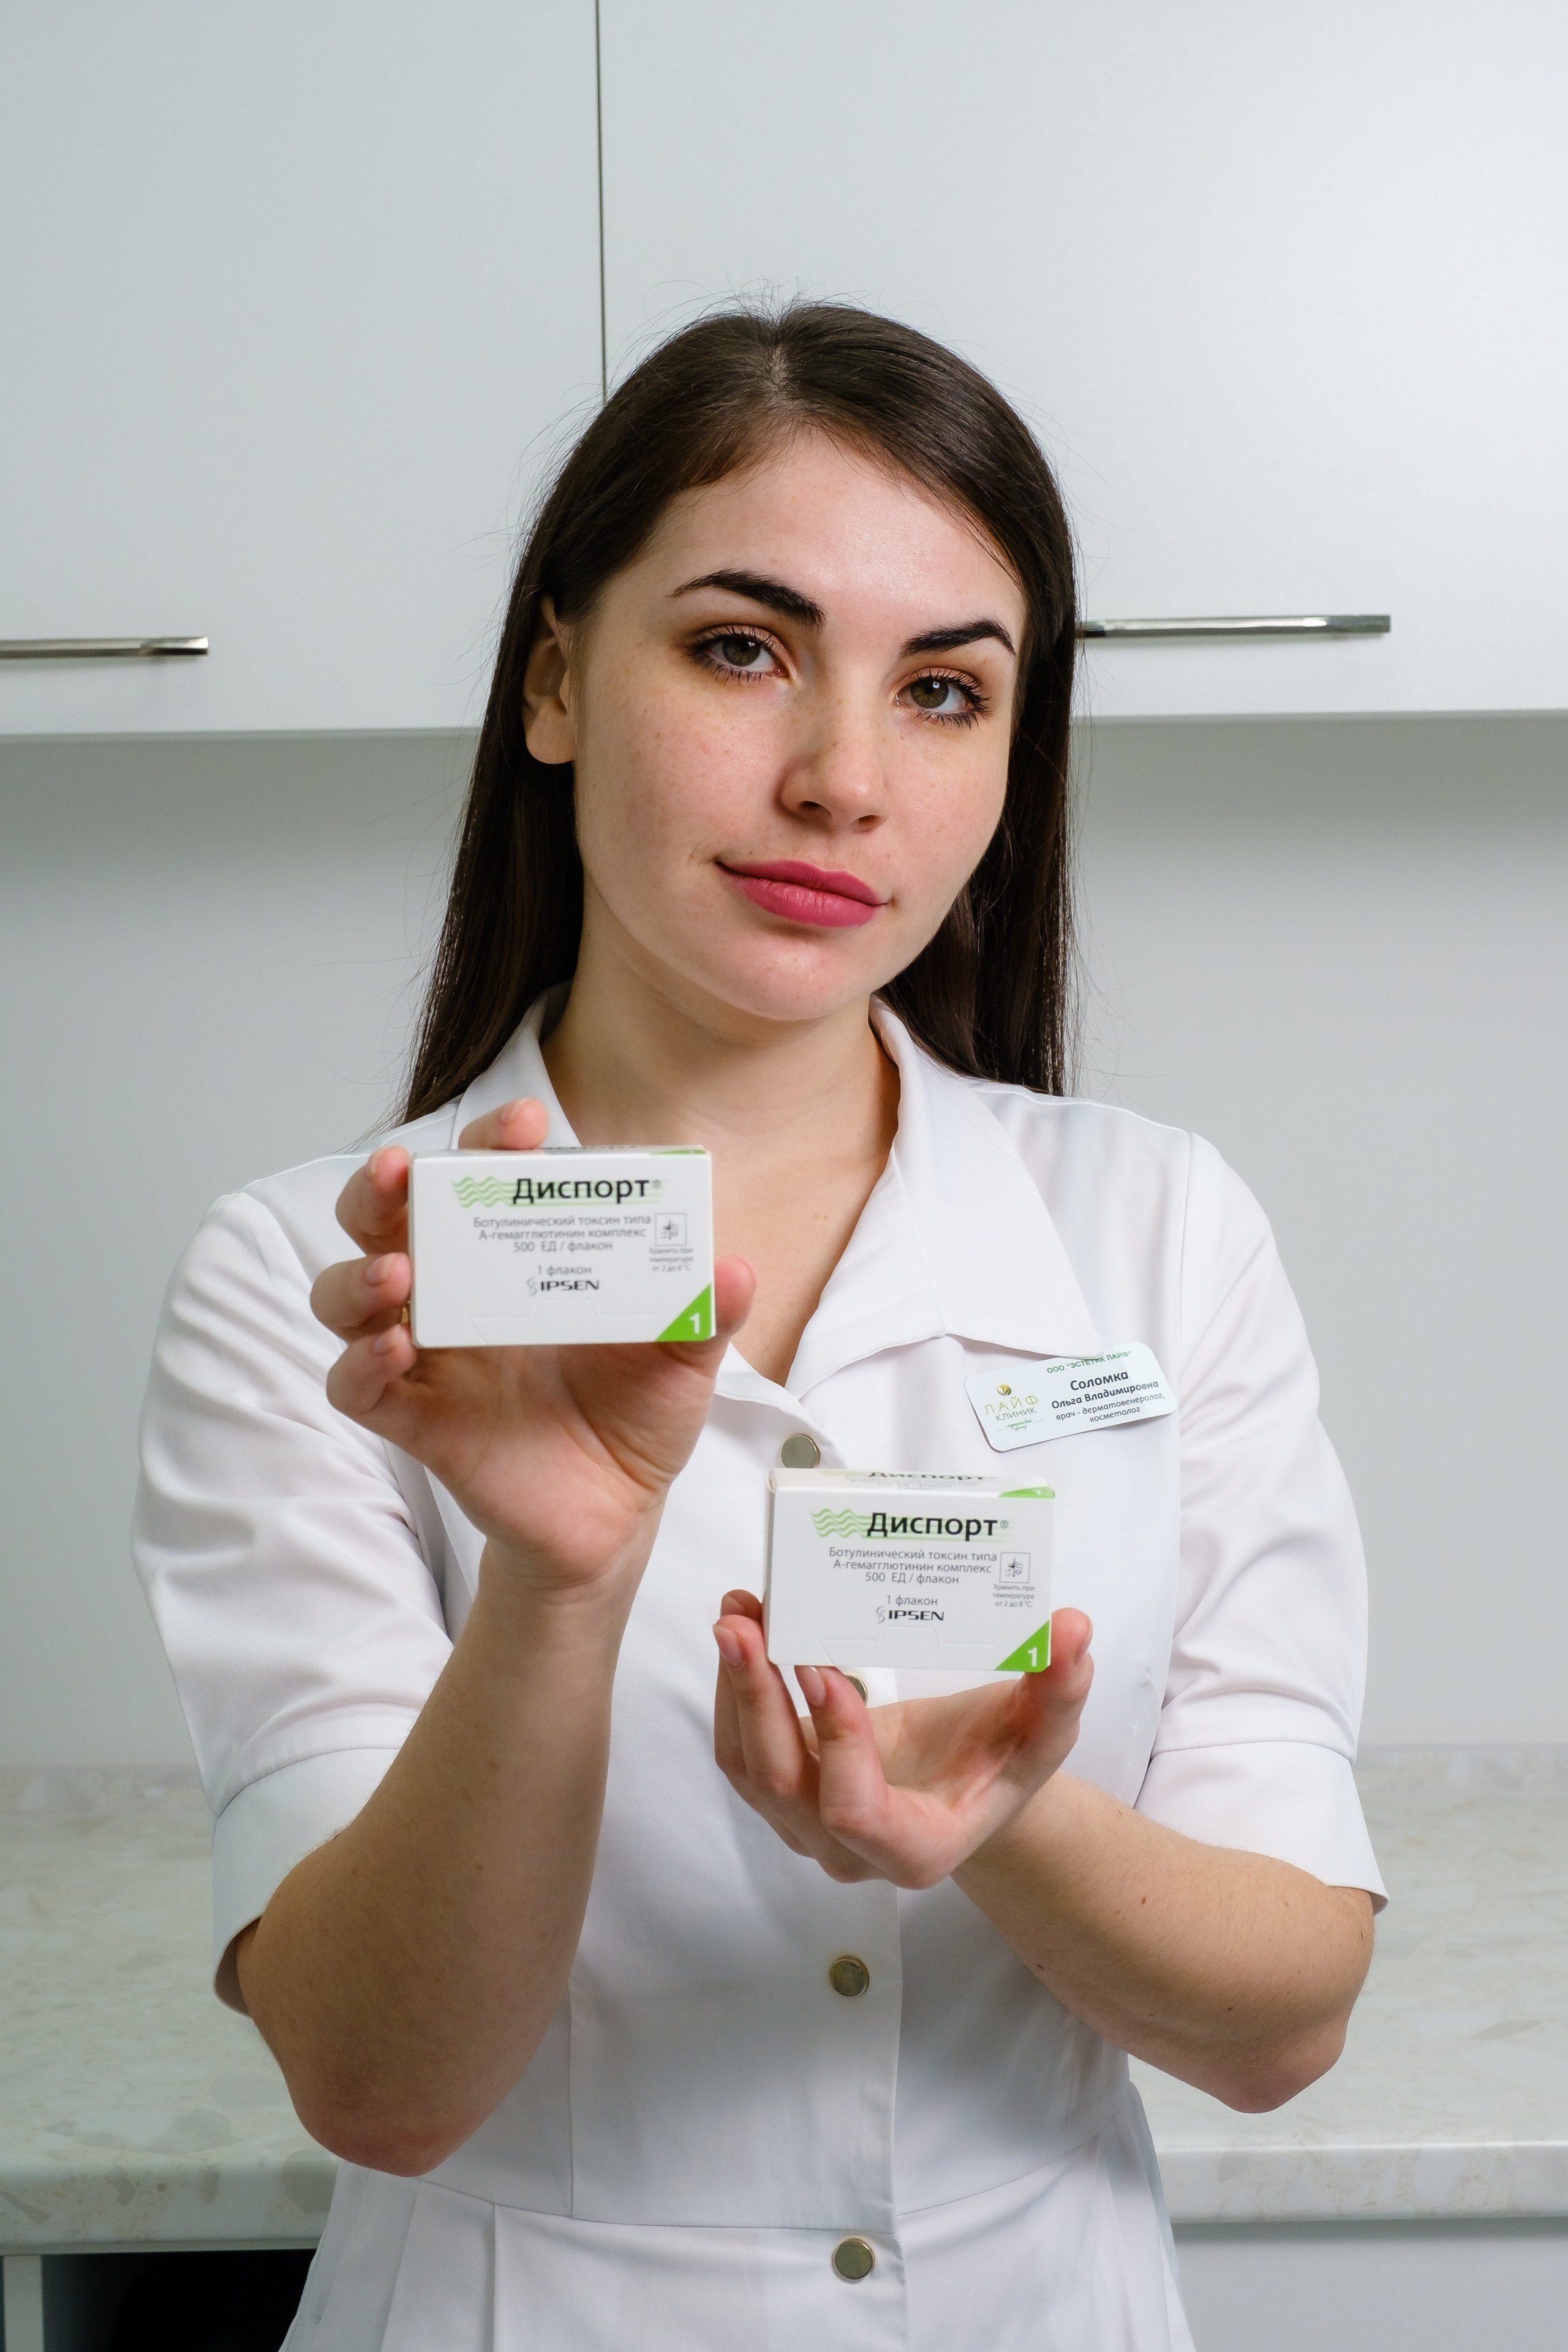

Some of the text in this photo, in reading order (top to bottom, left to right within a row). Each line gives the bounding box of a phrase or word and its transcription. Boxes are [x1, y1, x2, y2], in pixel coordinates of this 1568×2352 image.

[579, 1215, 620, 1225] токсин
[624, 1215, 651, 1224] типа
[588, 1227, 646, 1238] комплекс
[513, 1241, 535, 1252] 500
[541, 1240, 557, 1253] ЕД
[567, 1240, 612, 1253] флакон
[538, 1264, 592, 1276] 1 флакон
[540, 1279, 600, 1291] IPSEN
[689, 1312, 701, 1335] 1
[1046, 1365, 1065, 1373] ООО
[1070, 1371, 1129, 1391] Соломка
[1052, 1381, 1159, 1409] Ольга Владимировна
[984, 1395, 1038, 1415] ЛАЙФ
[1056, 1411, 1076, 1421] врач
[1082, 1392, 1165, 1415] дерматовенеролог,
[995, 1407, 1038, 1422] КЛИНИК
[1090, 1406, 1141, 1423] косметолог
[829, 1547, 997, 1561] Ботулинический токсин типа
[833, 1559, 933, 1571] А-гемагглютинин
[937, 1563, 992, 1574] комплекс
[865, 1572, 959, 1585] 500 ЕД / флакон
[887, 1594, 938, 1607] 1 флакон
[888, 1610, 944, 1621] IPSEN
[1028, 1647, 1039, 1667] 1
